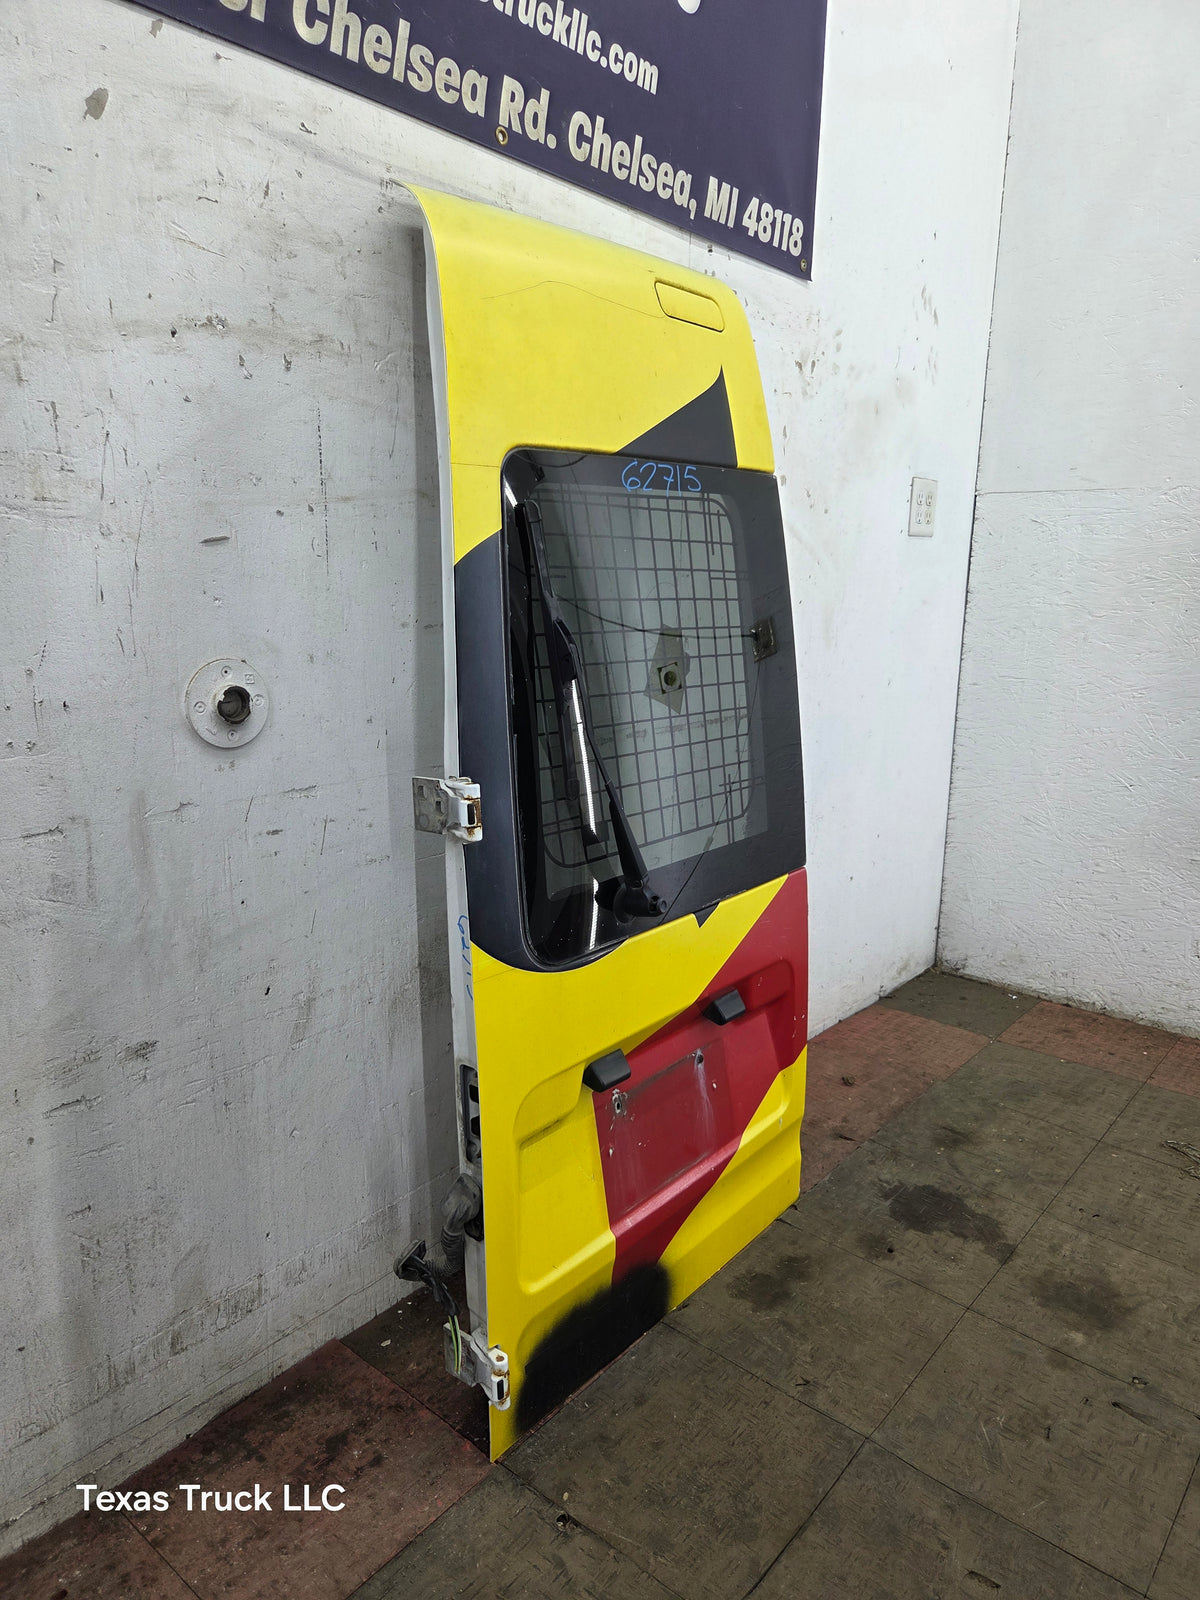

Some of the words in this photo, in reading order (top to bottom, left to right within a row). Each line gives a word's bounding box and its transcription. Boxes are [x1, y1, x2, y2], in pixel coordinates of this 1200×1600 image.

[292, 0, 489, 118] Chelsea
[499, 74, 557, 149] Rd.
[568, 110, 697, 220] Chelsea,
[704, 175, 739, 228] MI
[742, 196, 804, 257] 48118
[621, 458, 702, 497] 62715
